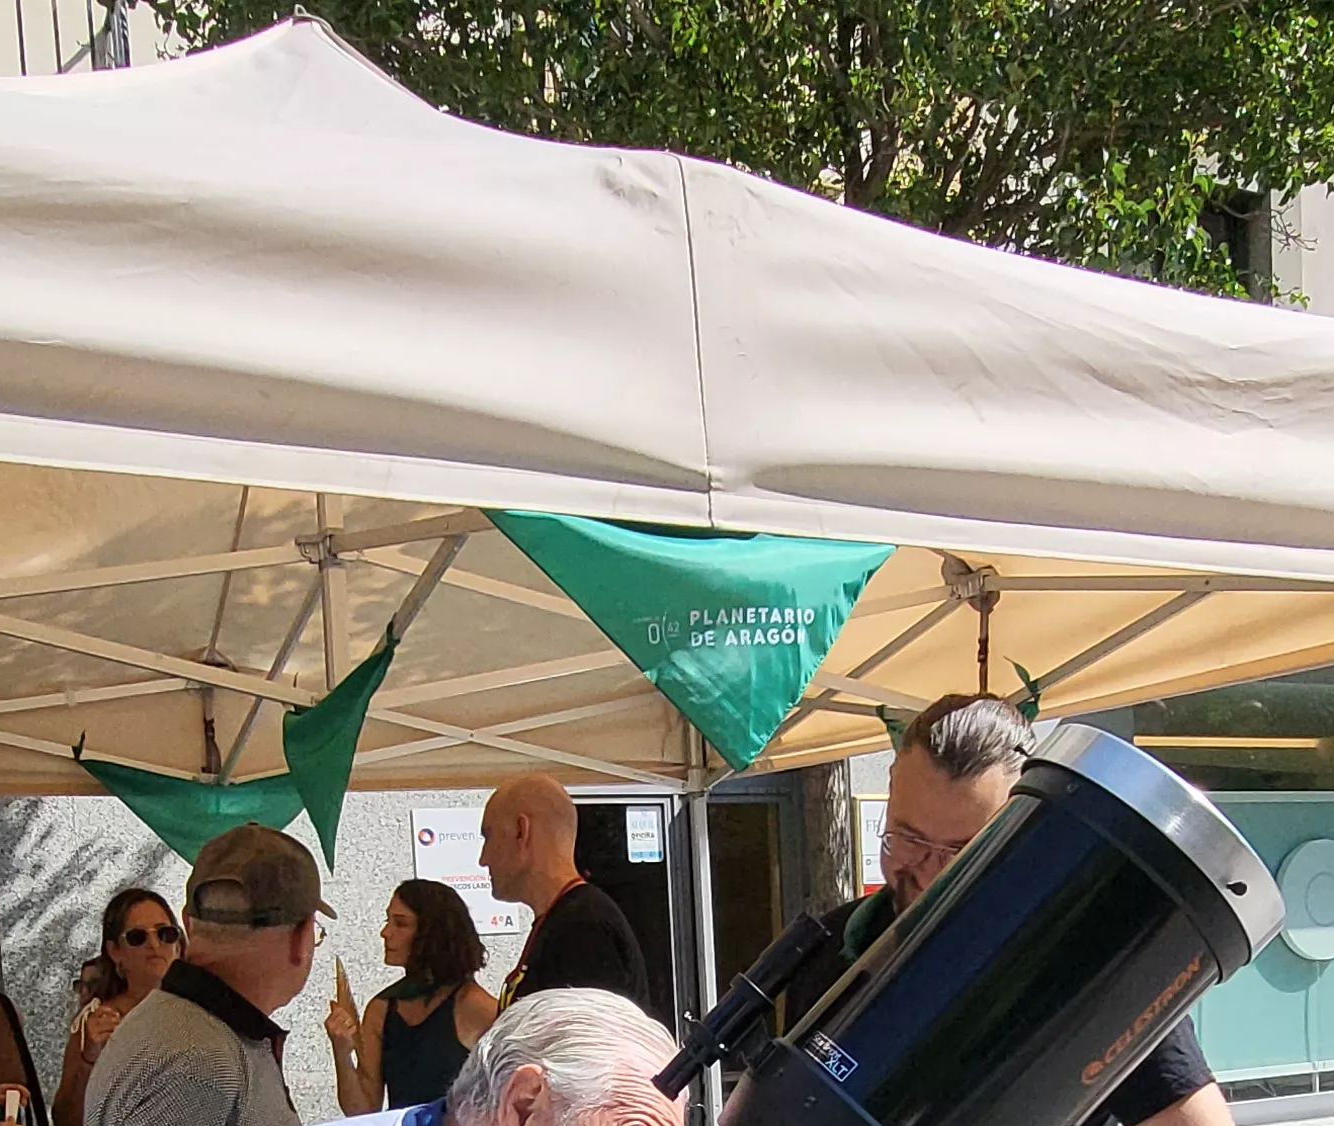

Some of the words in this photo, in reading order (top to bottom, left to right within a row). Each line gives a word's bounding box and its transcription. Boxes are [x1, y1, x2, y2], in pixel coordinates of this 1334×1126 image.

[689, 606, 815, 627] PLANETARIO
[691, 629, 716, 648] DE
[725, 624, 807, 647] ARAGÓN
[824, 1055, 849, 1078] XLT
